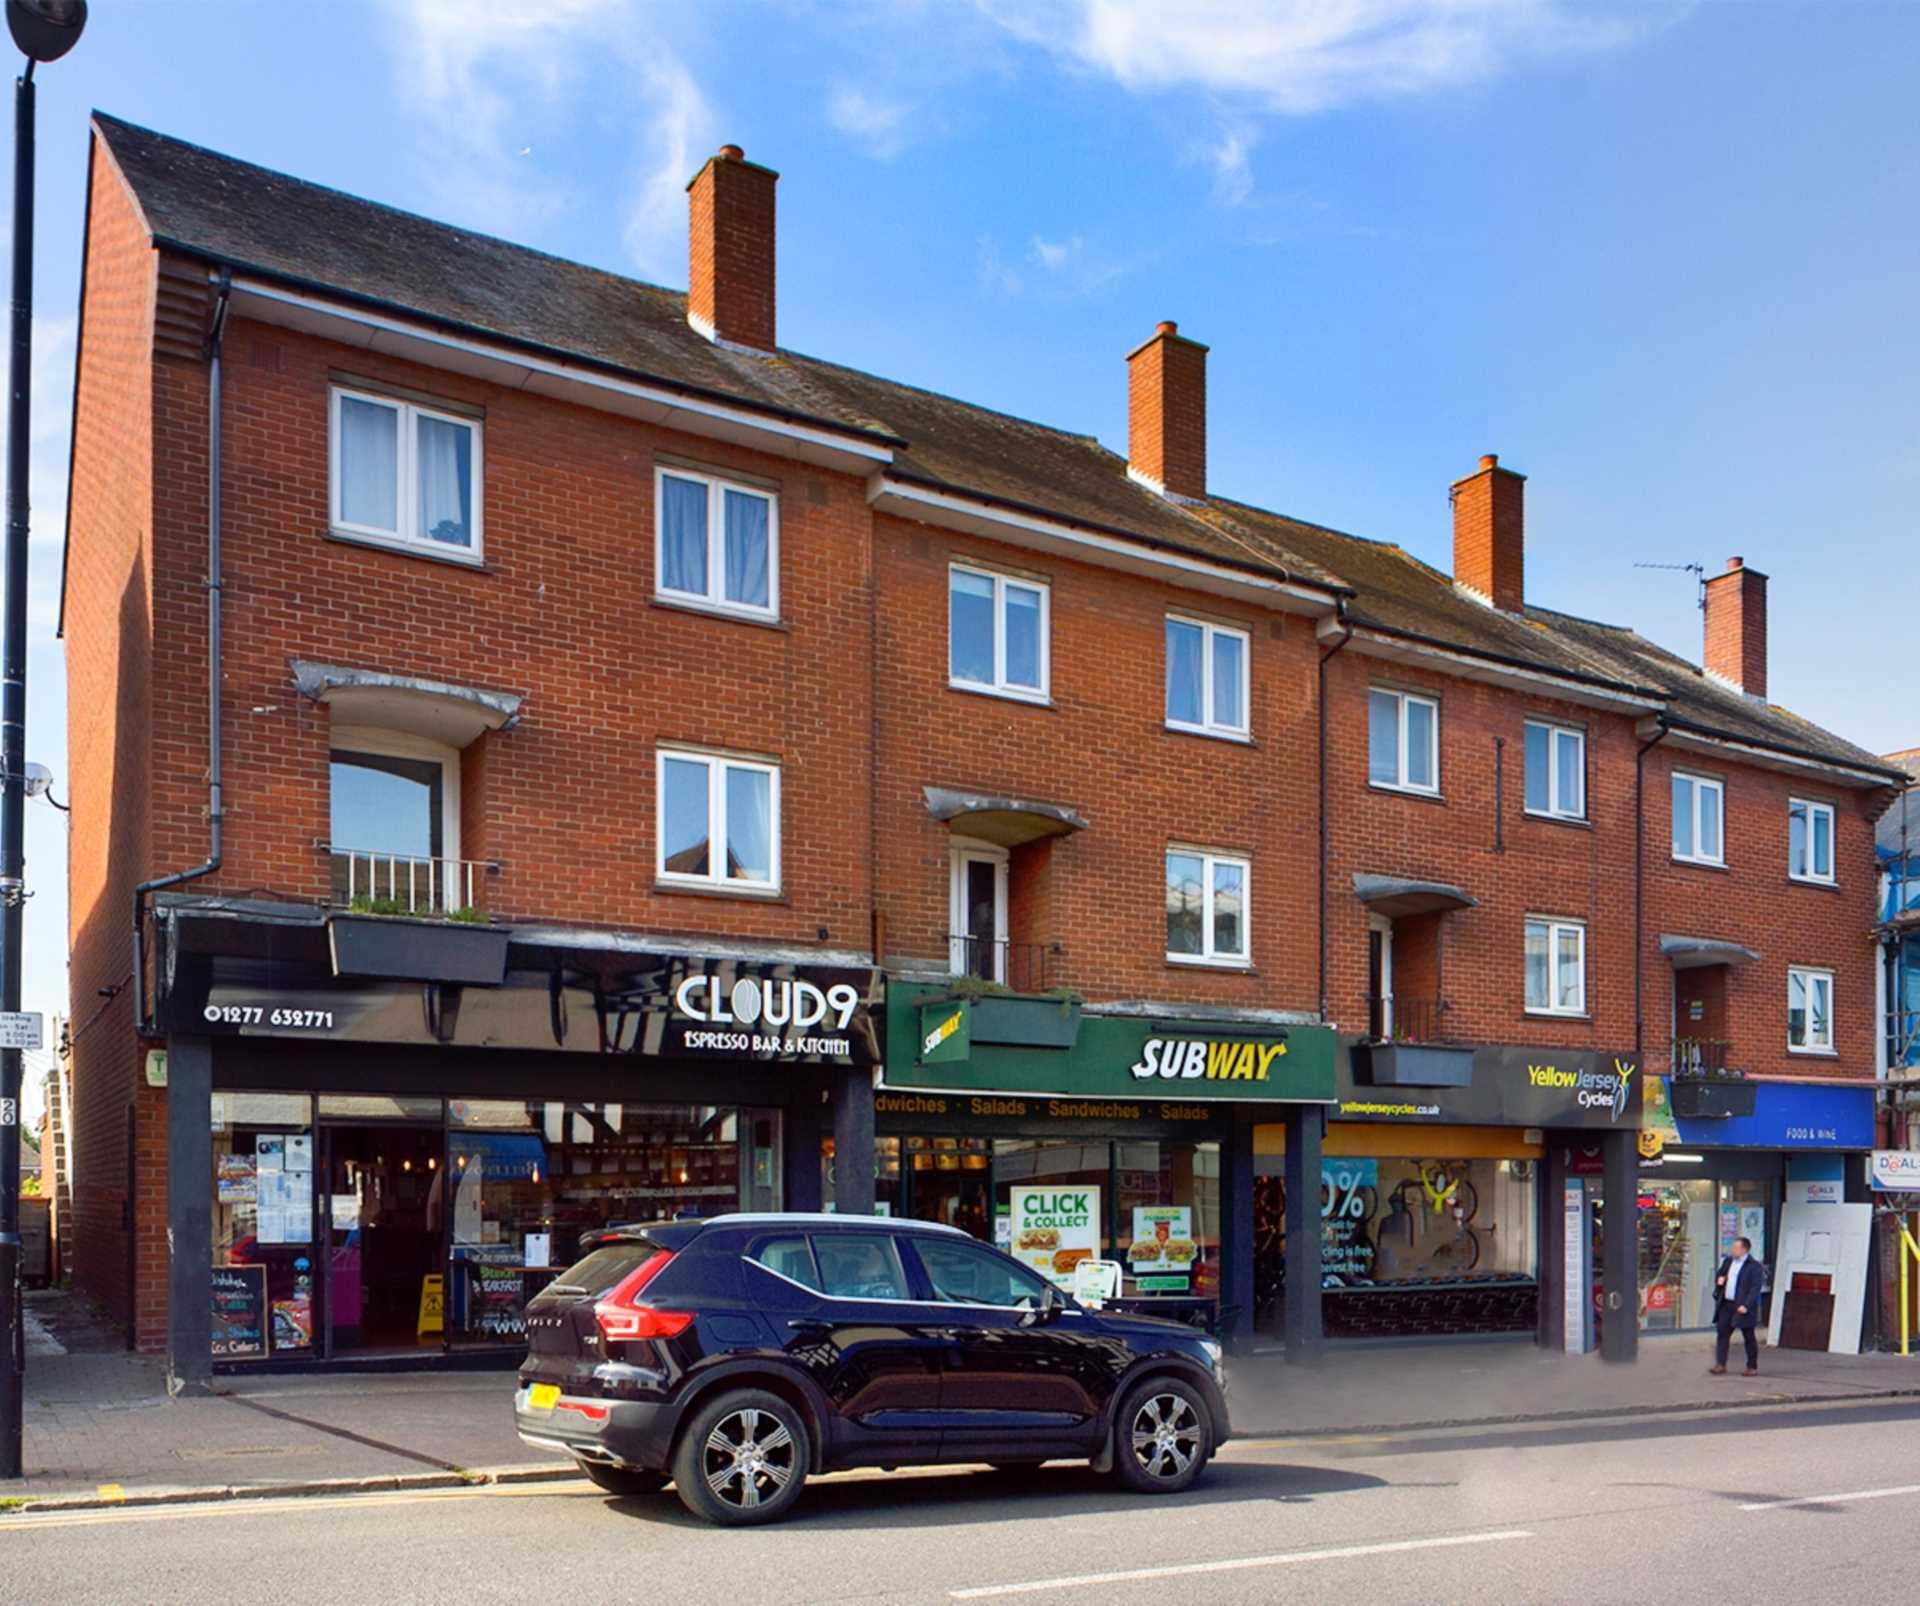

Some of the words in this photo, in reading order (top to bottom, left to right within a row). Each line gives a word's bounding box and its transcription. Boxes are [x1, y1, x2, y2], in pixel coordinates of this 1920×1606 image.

[203, 1005, 264, 1023] 01277
[270, 1008, 333, 1028] 632771
[684, 1030, 749, 1050] ESPRESSO
[752, 1035, 781, 1052] BAR
[784, 1041, 794, 1053] &
[797, 1037, 850, 1056] KITCHEN
[923, 1010, 963, 1054] SUBWAY
[1131, 1039, 1287, 1081] SUBWAY
[971, 1100, 1025, 1116] Salads
[1049, 1101, 1140, 1119] Sandwiches
[1161, 1103, 1209, 1120] Salads
[1577, 1090, 1614, 1109] Cycles
[1786, 1128, 1807, 1139] FOOD
[1023, 1193, 1089, 1215] CLICK
[1023, 1217, 1031, 1229] &
[1034, 1216, 1089, 1228] COLLECT
